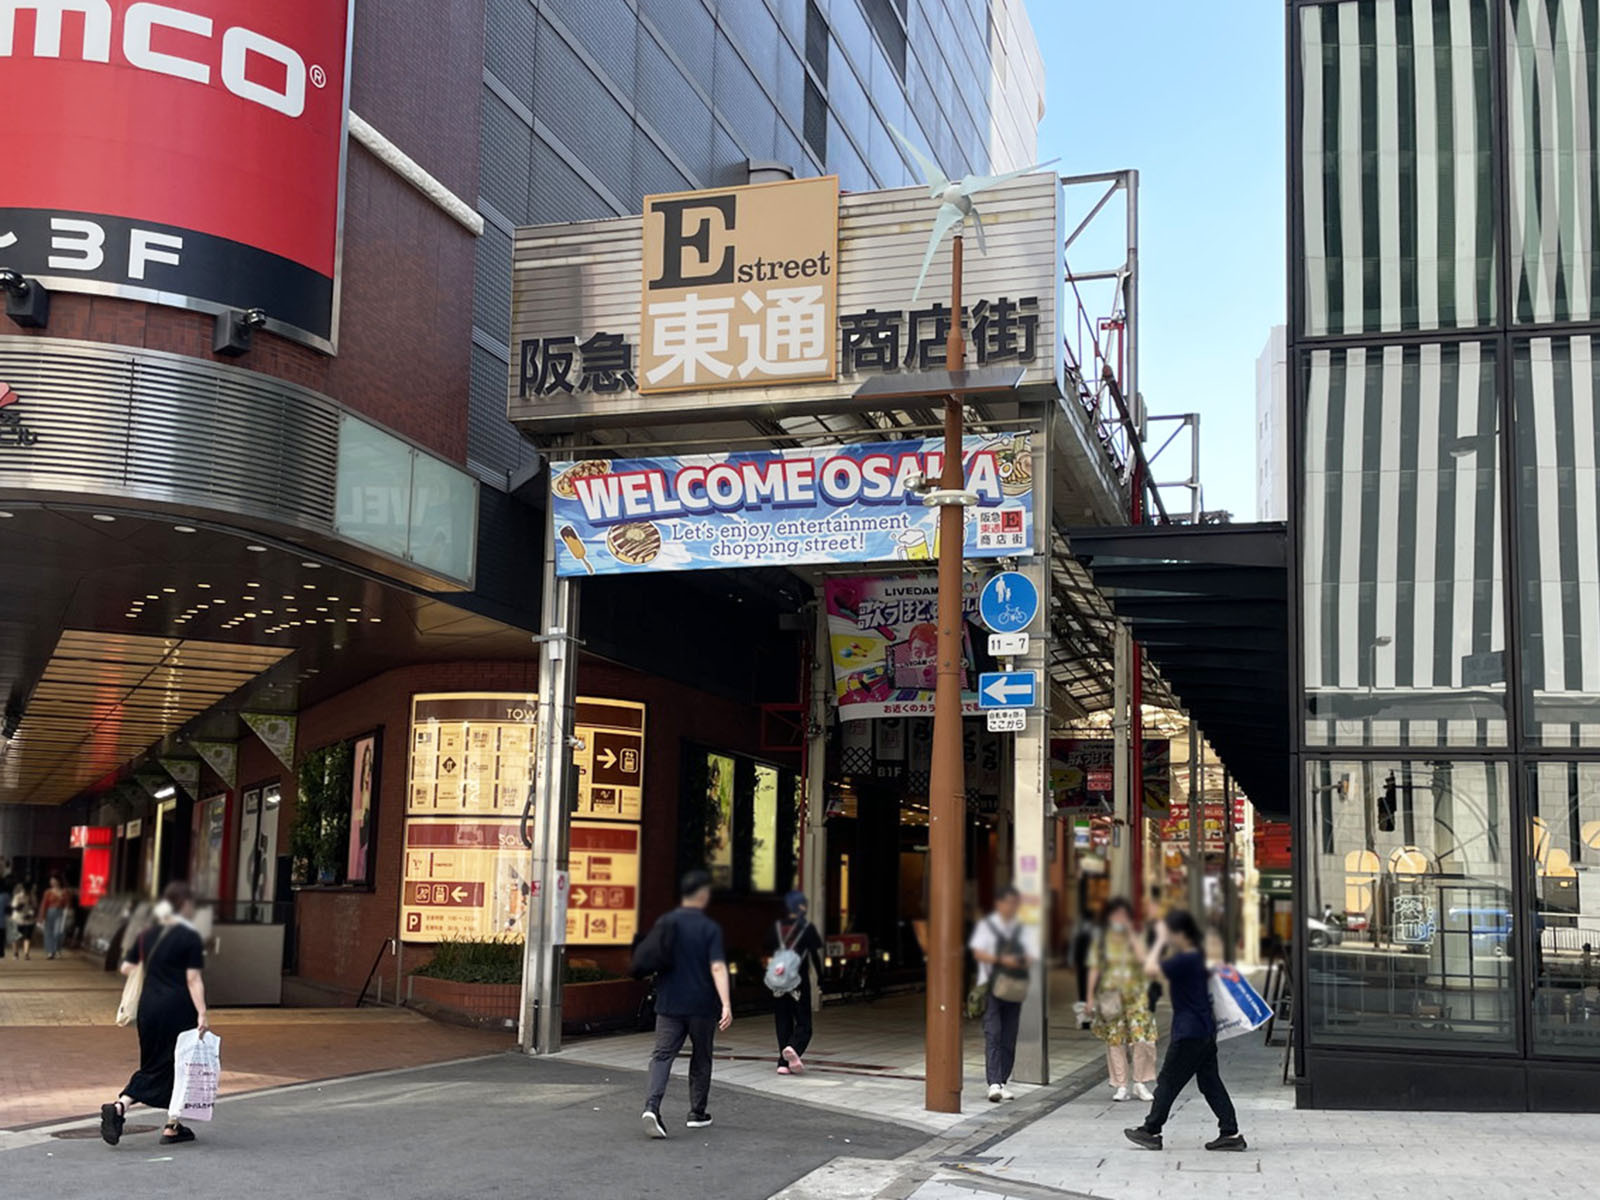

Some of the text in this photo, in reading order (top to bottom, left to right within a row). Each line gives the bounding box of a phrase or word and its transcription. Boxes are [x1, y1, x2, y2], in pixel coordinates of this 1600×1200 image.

[649, 194, 831, 290] E street
[519, 285, 1039, 398] 阪急 東通 商店街
[573, 457, 816, 526] WELCOME
[672, 513, 909, 545] Let's enjoy entertainment
[712, 533, 865, 560] shopping street!
[988, 719, 1025, 731] ここから
